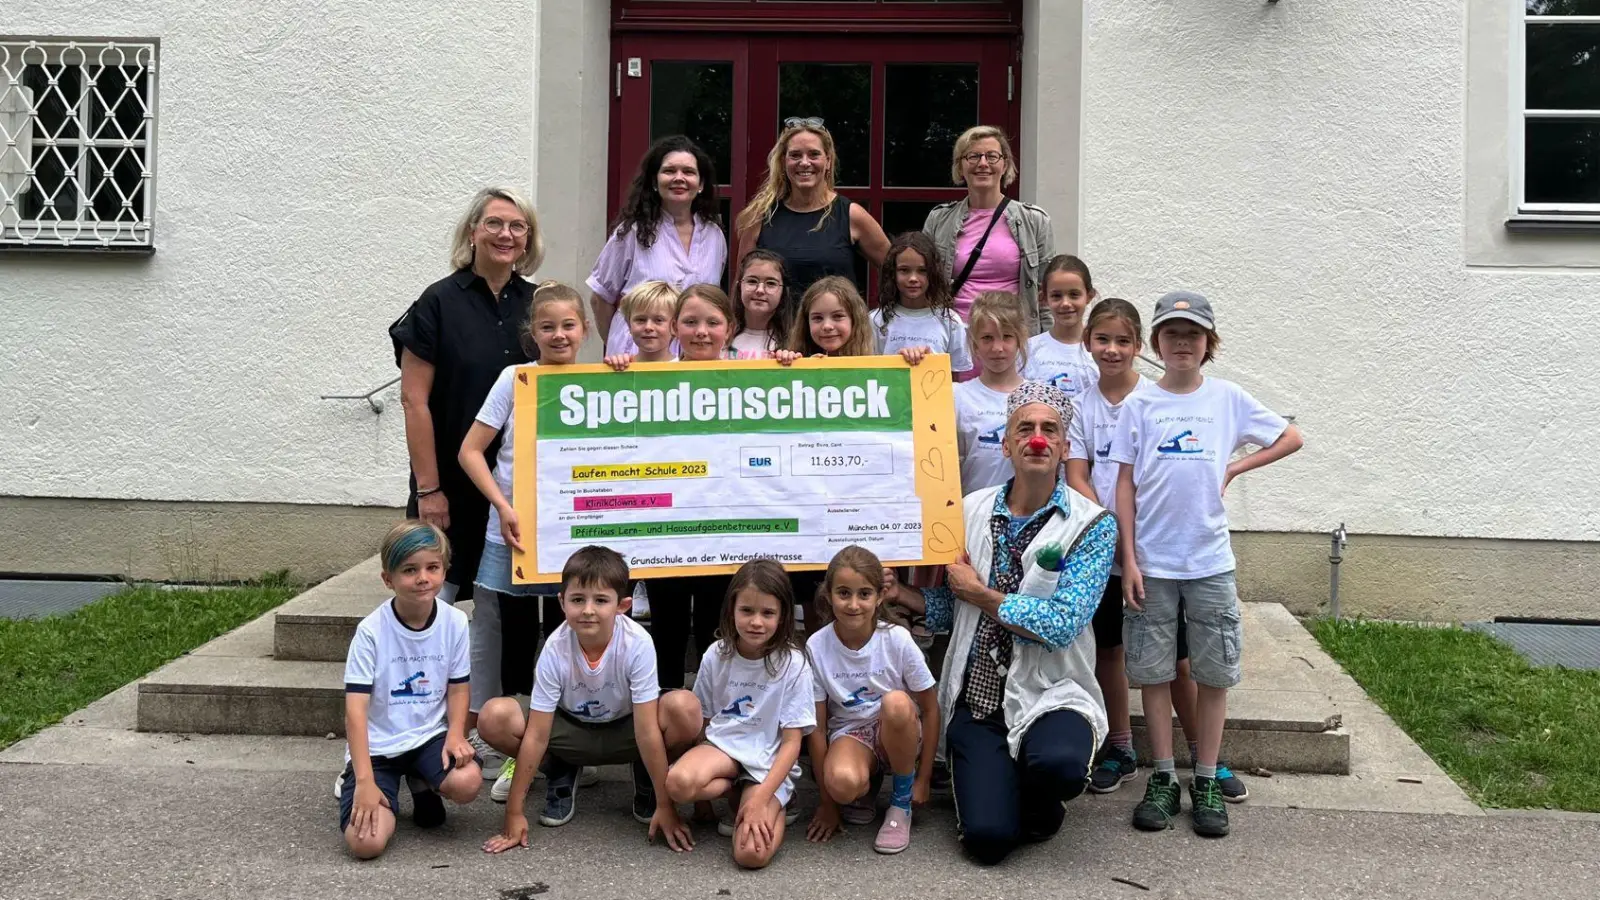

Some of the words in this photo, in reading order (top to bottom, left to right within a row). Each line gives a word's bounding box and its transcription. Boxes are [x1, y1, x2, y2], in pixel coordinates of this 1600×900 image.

[559, 380, 890, 428] Spendenscheck
[749, 457, 772, 467] EUR
[572, 469, 607, 479] Laufen
[611, 467, 641, 477] macht
[644, 465, 678, 476] Schule
[682, 464, 707, 475] 2023
[585, 497, 638, 508] KlinikClowns
[575, 527, 615, 537] Pfiffikus
[619, 527, 642, 536] Lern-
[647, 525, 663, 534] und
[666, 521, 771, 534] Hausaufgabenbetreuung
[630, 555, 683, 565] Grundschule
[700, 554, 716, 562] der
